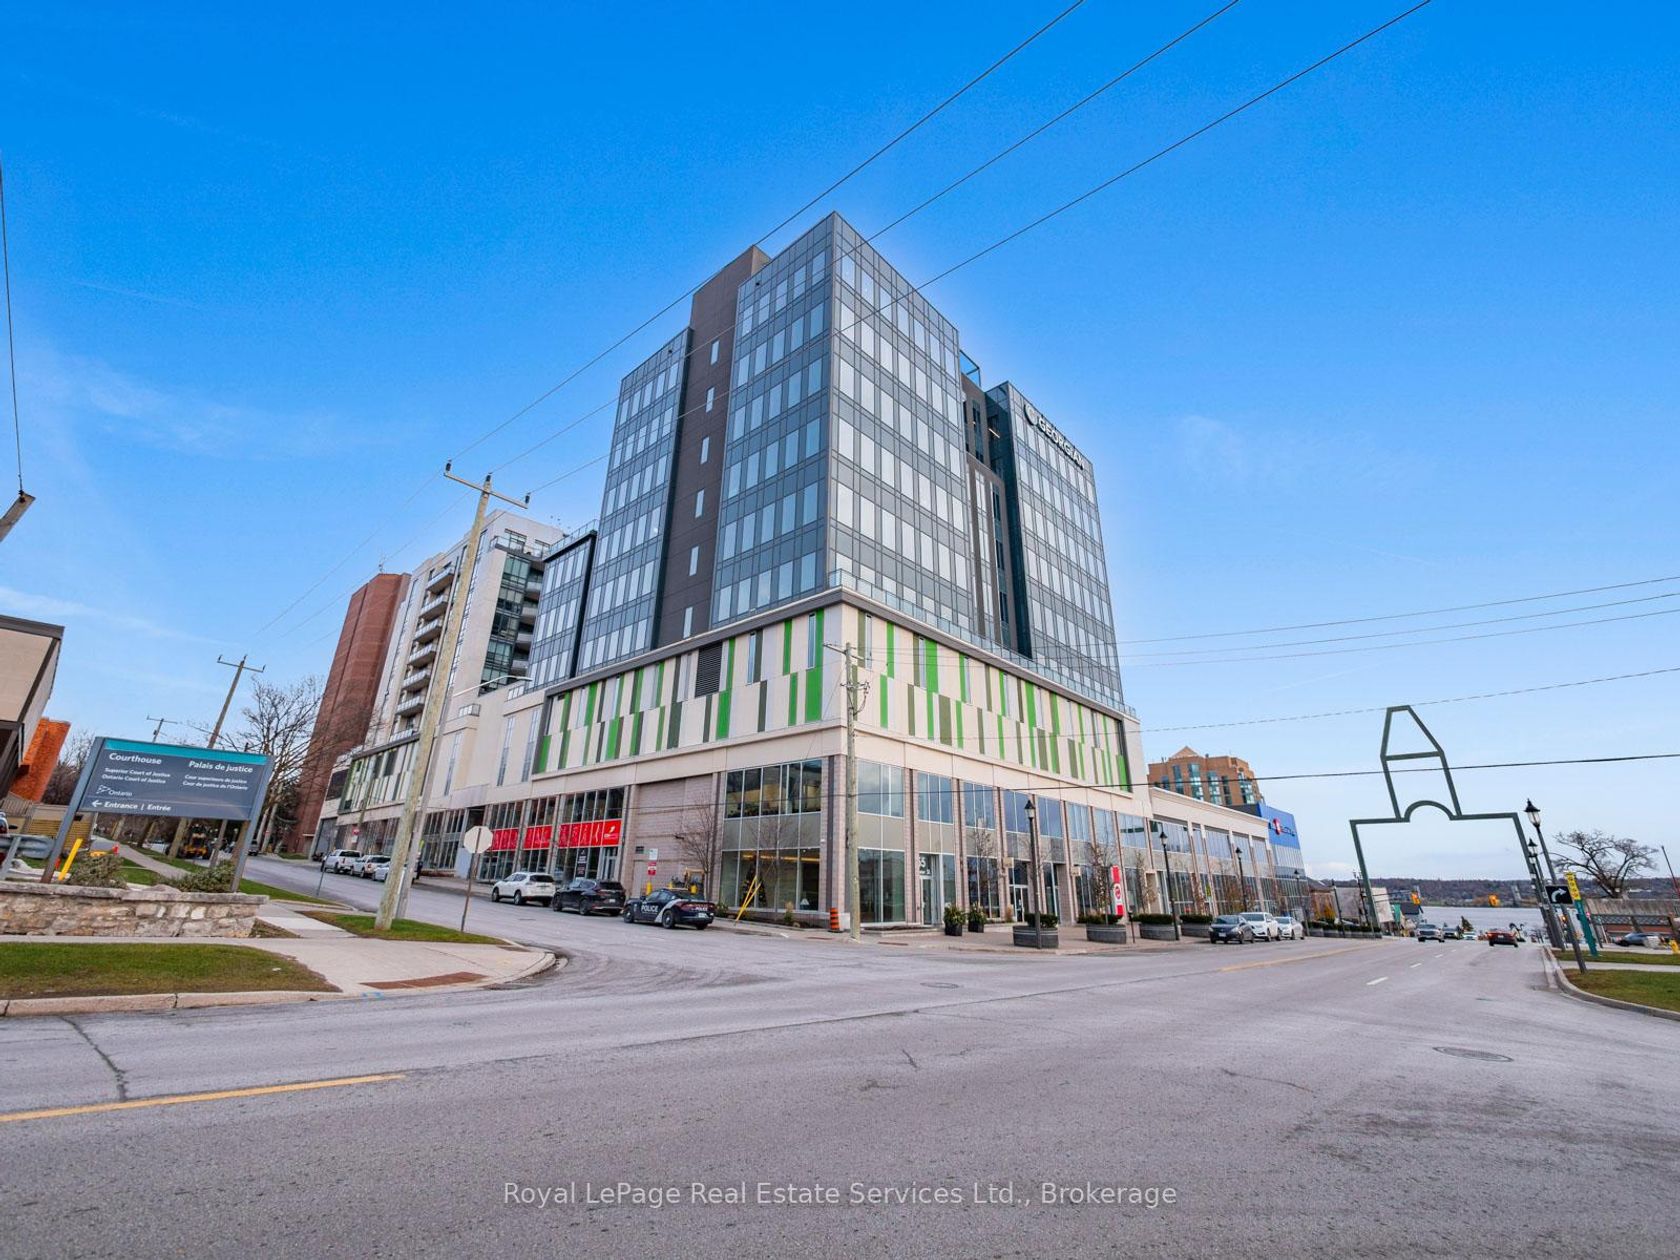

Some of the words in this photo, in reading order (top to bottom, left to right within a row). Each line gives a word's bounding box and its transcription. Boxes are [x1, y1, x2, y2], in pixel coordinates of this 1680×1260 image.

[109, 752, 162, 765] Courthouse
[104, 767, 128, 775] Superior
[188, 760, 213, 770] Palais
[225, 764, 253, 773] justice
[104, 801, 138, 810] Entrance
[147, 803, 171, 811] Entrée
[641, 904, 659, 913] POLICE
